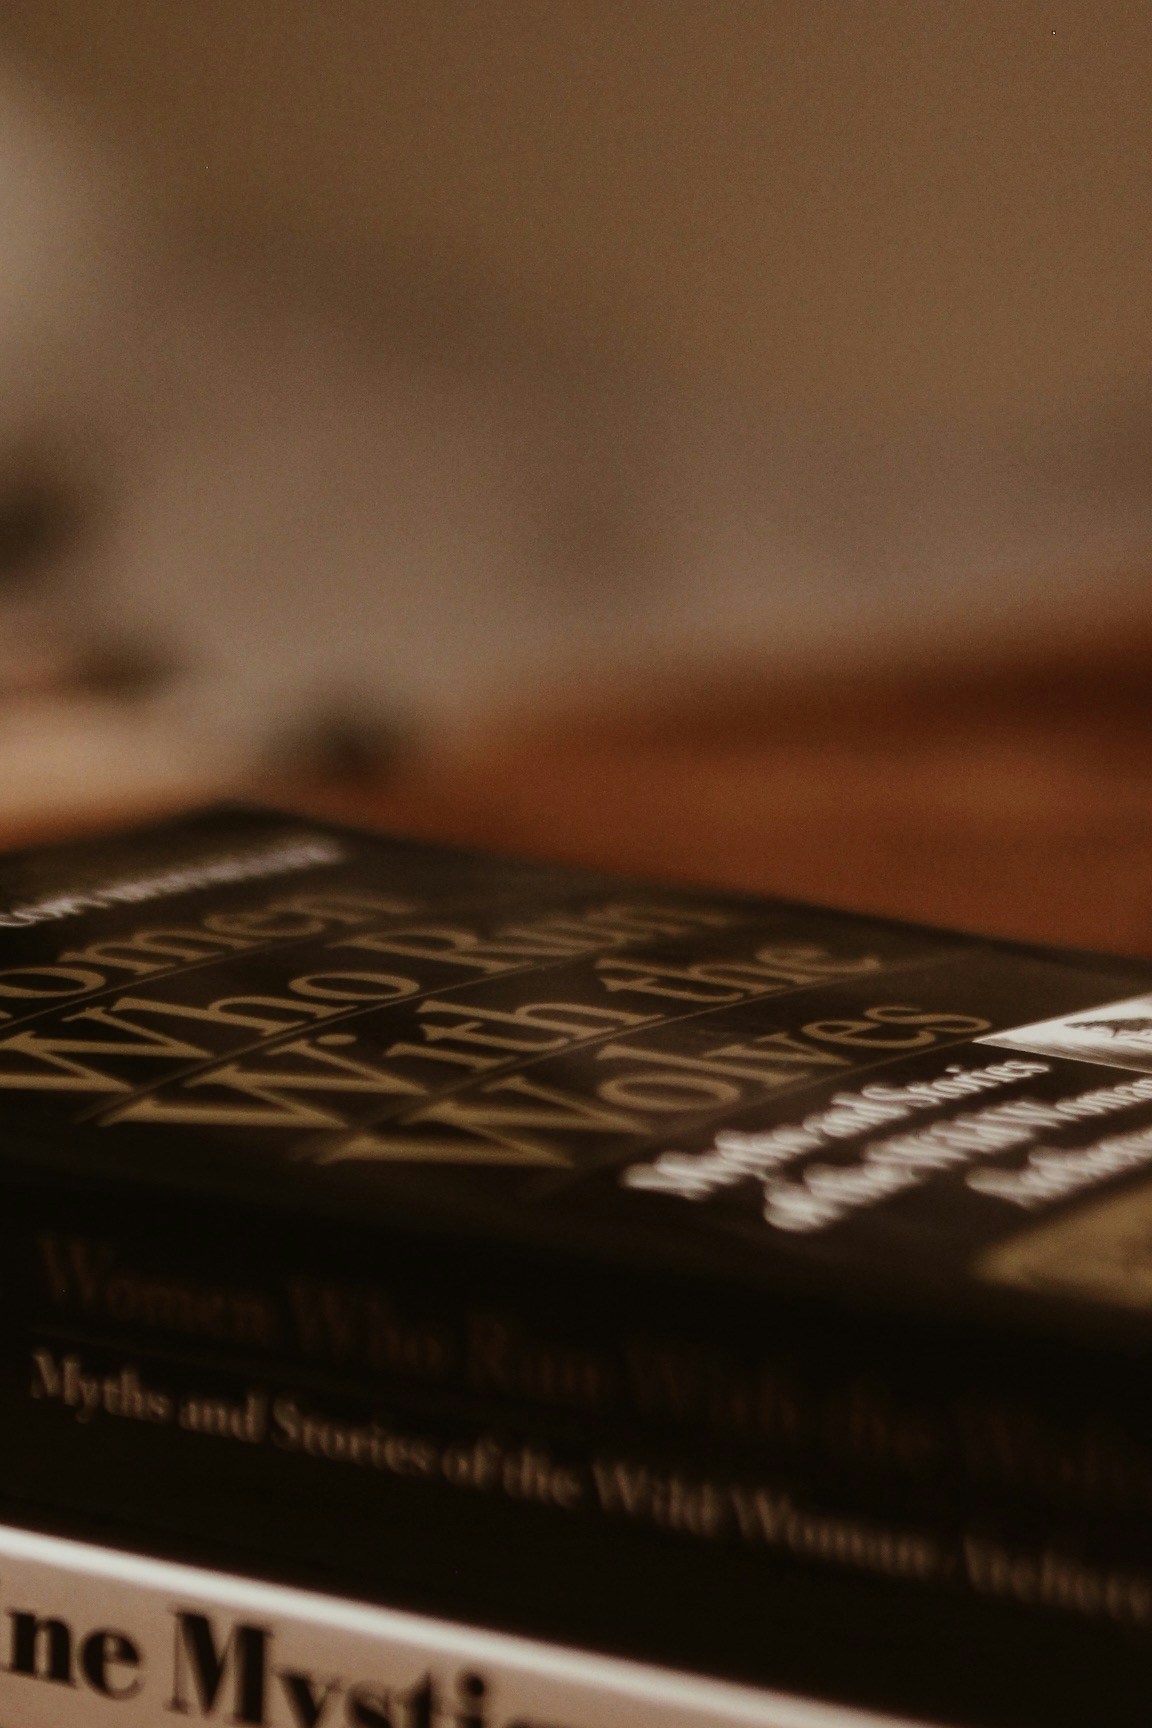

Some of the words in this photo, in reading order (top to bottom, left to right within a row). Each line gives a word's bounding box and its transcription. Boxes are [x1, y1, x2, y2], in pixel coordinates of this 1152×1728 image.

[325, 903, 730, 973] Run
[96, 999, 664, 1128] With
[595, 945, 881, 1001] the
[315, 1004, 992, 1168] Wolves
[860, 1058, 1050, 1108] Stories
[31, 1346, 173, 1422] Myths
[179, 1390, 267, 1444] and
[271, 1396, 440, 1477] Stories
[441, 1434, 502, 1490] of
[502, 1443, 583, 1508] the
[592, 1460, 726, 1539] Wild
